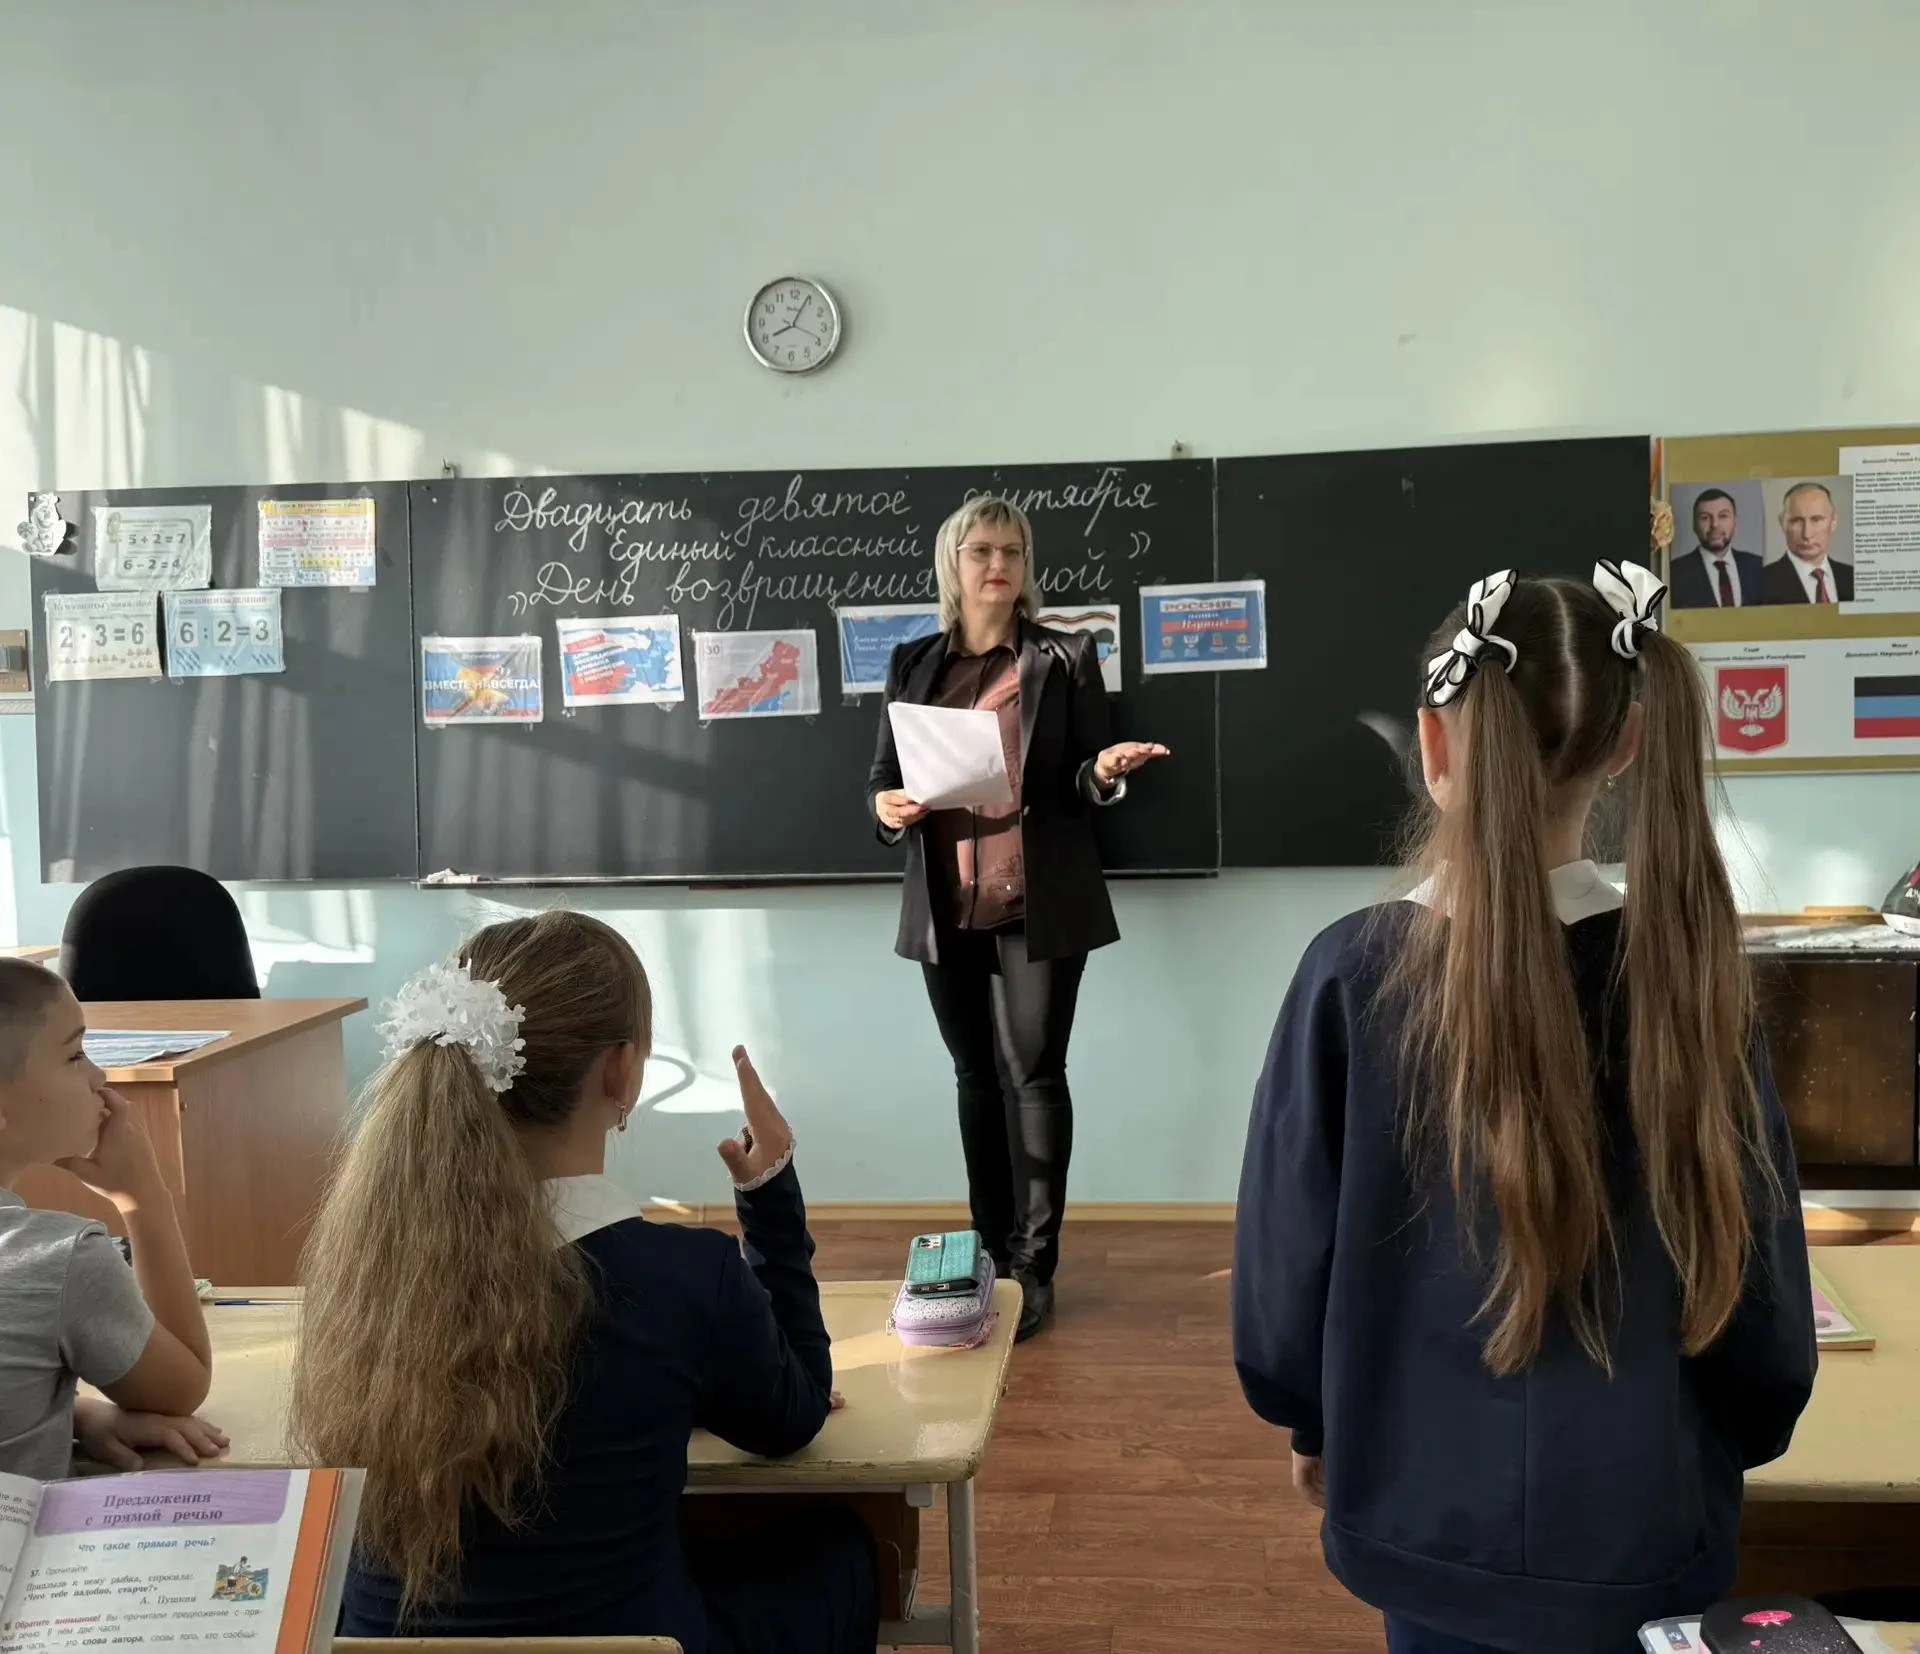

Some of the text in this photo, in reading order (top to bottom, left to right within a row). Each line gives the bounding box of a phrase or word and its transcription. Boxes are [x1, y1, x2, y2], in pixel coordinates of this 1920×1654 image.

[776, 294, 784, 303] 11
[790, 290, 800, 300] 12
[765, 304, 775, 314] 10
[817, 307, 824, 317] 2
[758, 318, 765, 328] 9
[820, 323, 828, 333] 3
[762, 334, 769, 344] 8
[774, 346, 780, 355] 7
[788, 351, 795, 361] 6
[804, 347, 810, 358] 5
[495, 487, 693, 552] Двадцать
[734, 474, 912, 547] девятое
[128, 534, 136, 545] 5
[152, 534, 161, 544] 2
[177, 533, 186, 544] 7
[609, 525, 924, 584] Единый классный
[123, 560, 132, 570] 6
[148, 559, 156, 570] 2
[665, 560, 938, 631] возвращения
[1164, 600, 1232, 612] РОССИЯ
[60, 625, 74, 648] 2
[95, 624, 108, 647] 3
[131, 622, 144, 645] 6
[180, 622, 194, 644] 6
[217, 620, 232, 642] 2
[255, 619, 268, 641] 3
[104, 1492, 212, 1508] Предложения
[85, 1509, 223, 1526] с прямой речью
[103, 1542, 130, 1552] такое
[137, 1540, 178, 1550] прямая
[184, 1537, 216, 1548] речь?
[157, 1595, 196, 1605] Пушкин
[82, 1638, 108, 1646] слова
